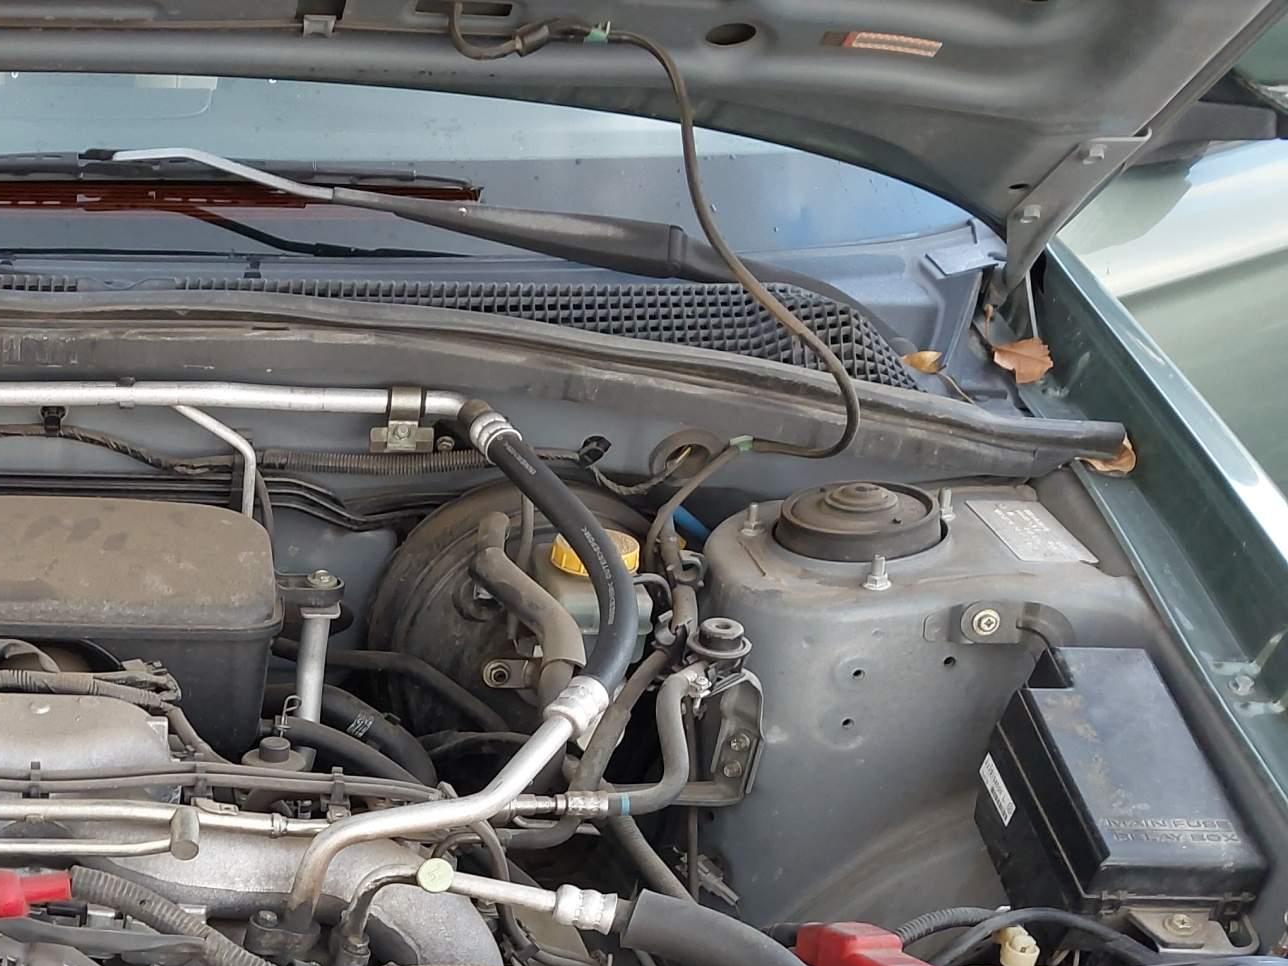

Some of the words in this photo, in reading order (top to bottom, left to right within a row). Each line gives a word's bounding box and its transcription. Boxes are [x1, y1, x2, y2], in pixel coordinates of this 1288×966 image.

[1105, 817, 1167, 828] MAIN
[1171, 818, 1234, 830] FUSE
[1189, 832, 1241, 843] BOX
